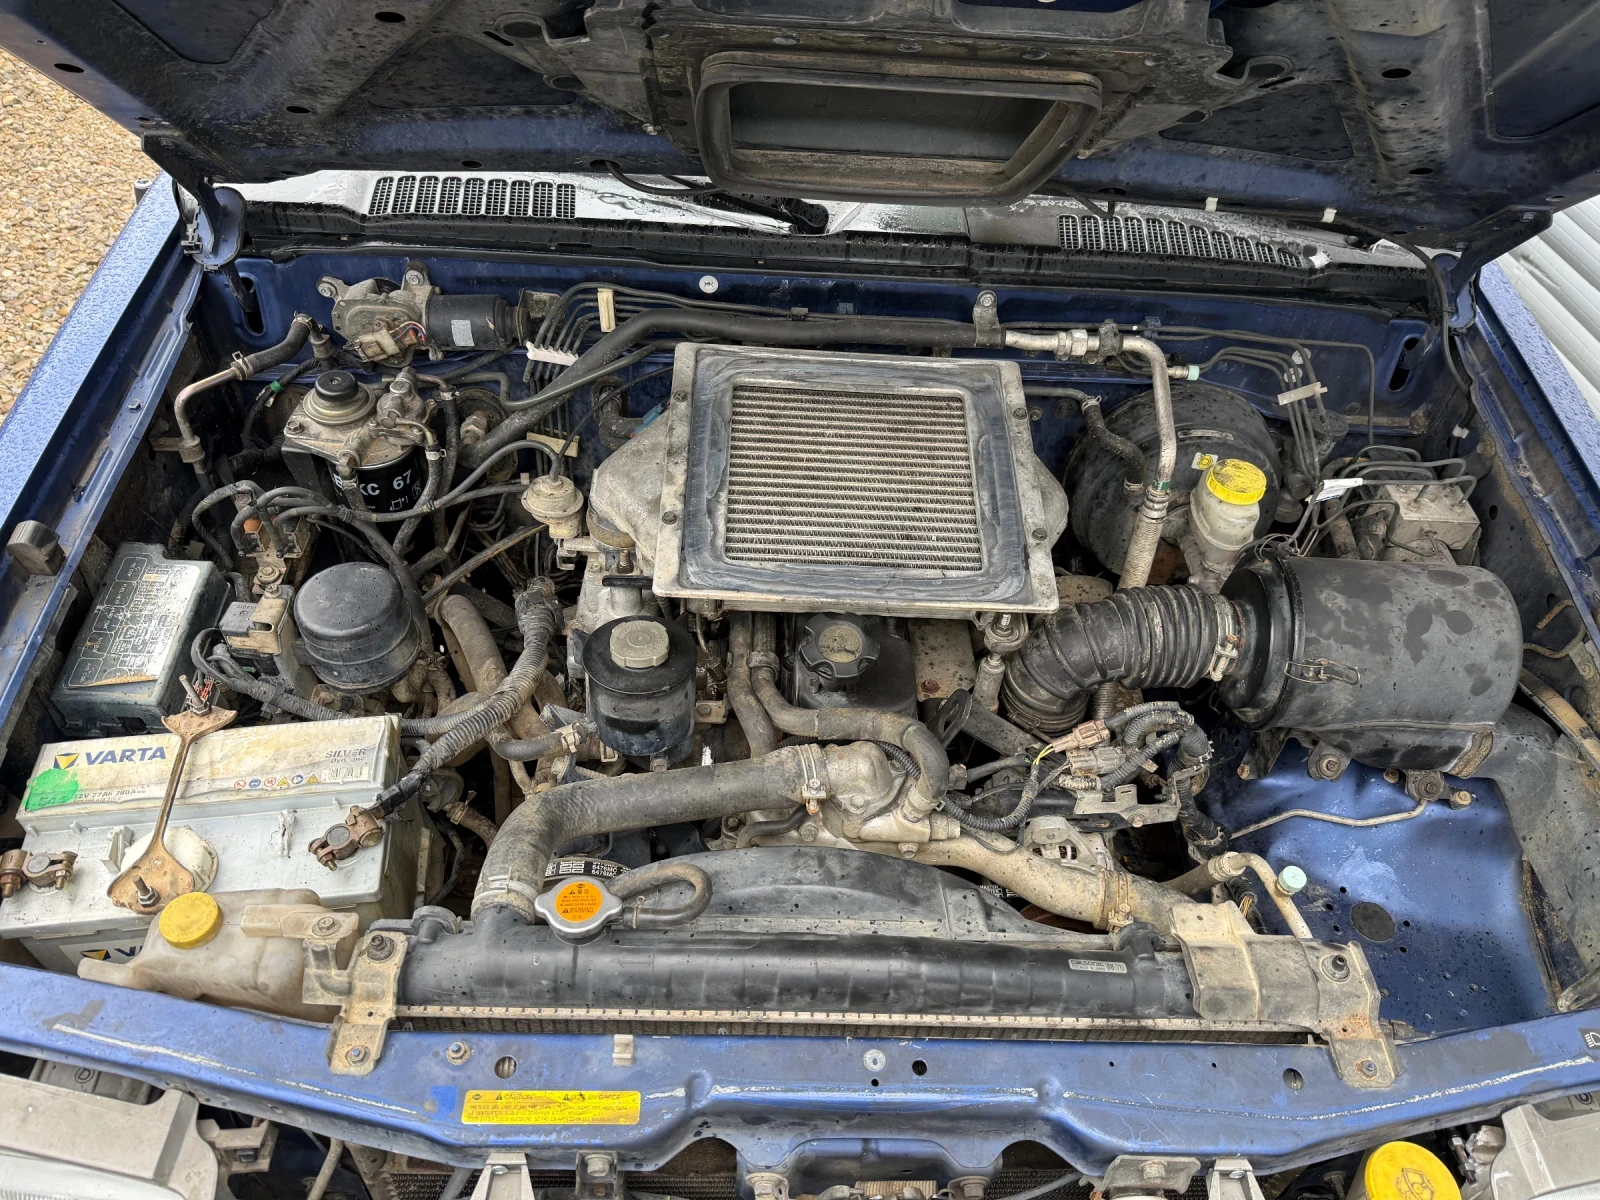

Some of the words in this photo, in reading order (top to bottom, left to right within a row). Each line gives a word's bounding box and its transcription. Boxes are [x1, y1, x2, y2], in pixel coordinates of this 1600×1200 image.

[392, 469, 412, 490] 67
[85, 746, 166, 765] VARTA
[324, 748, 366, 758] SILVER
